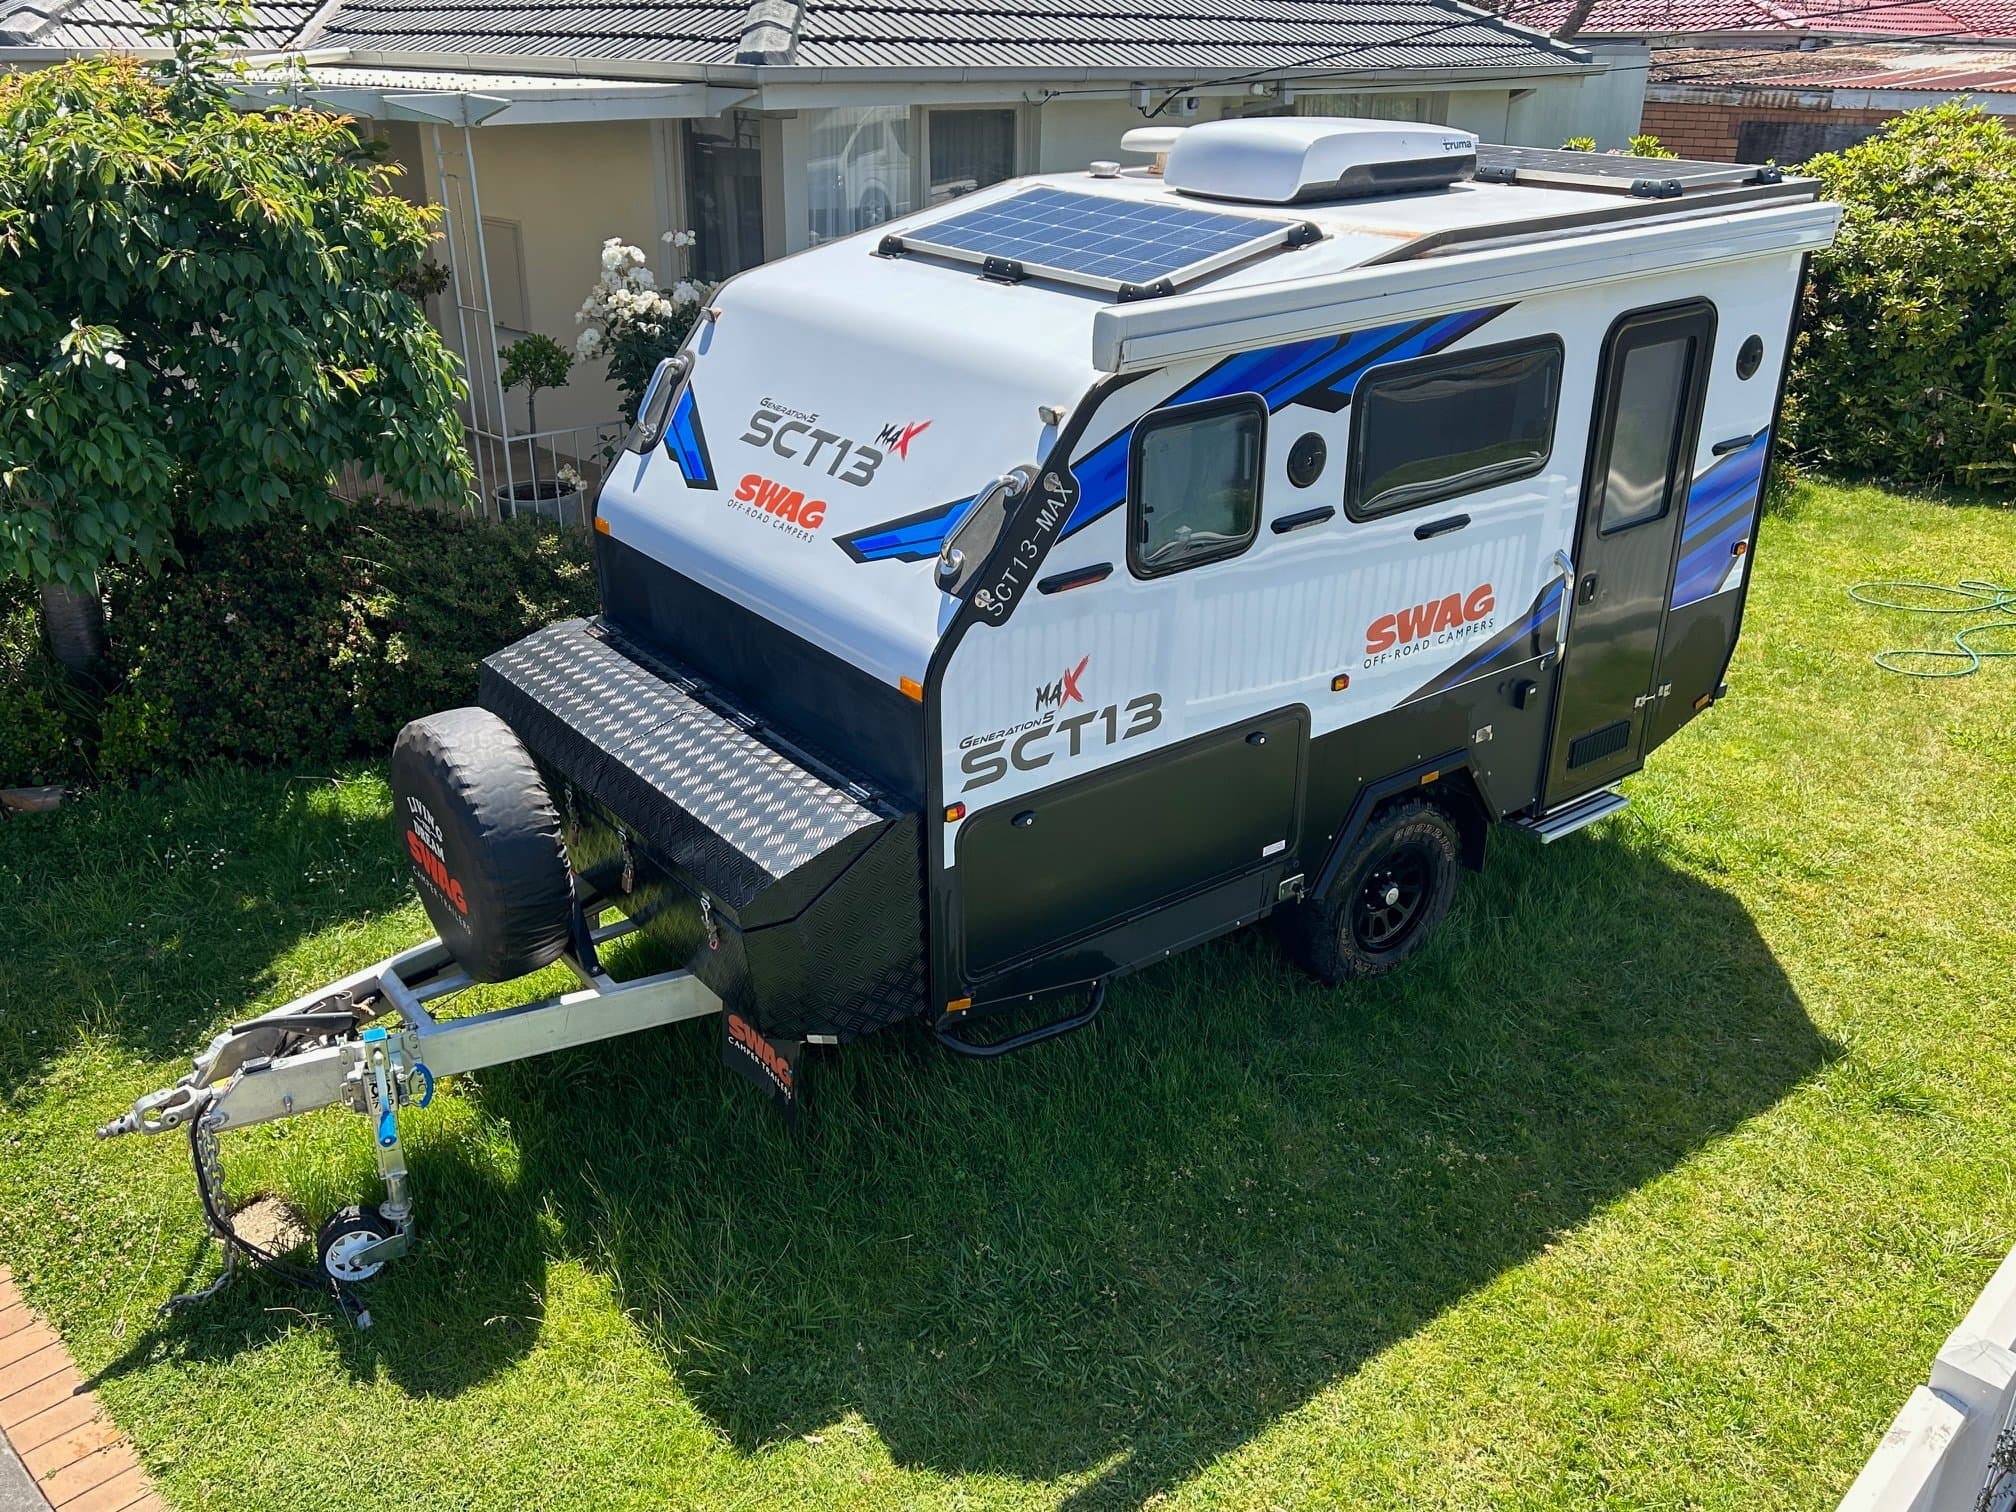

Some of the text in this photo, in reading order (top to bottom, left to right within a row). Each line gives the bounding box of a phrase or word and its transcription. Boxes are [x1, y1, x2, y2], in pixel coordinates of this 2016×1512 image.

[1442, 139, 1472, 151] truma
[739, 409, 883, 487] SCT13
[875, 420, 933, 461] MAX
[727, 499, 815, 544] OFF-ROAD CAMPERS
[734, 474, 827, 529] SWAG
[986, 480, 1073, 617] SCT13-MAX
[1363, 617, 1494, 669] OFF-ROAD CAMPERS
[1366, 583, 1496, 654] SWAG
[1035, 654, 1090, 712] MAX
[960, 692, 1163, 793] SCT13
[407, 830, 468, 914] SWAG
[728, 1014, 792, 1086] SWAG
[728, 1036, 760, 1064] CAMPER
